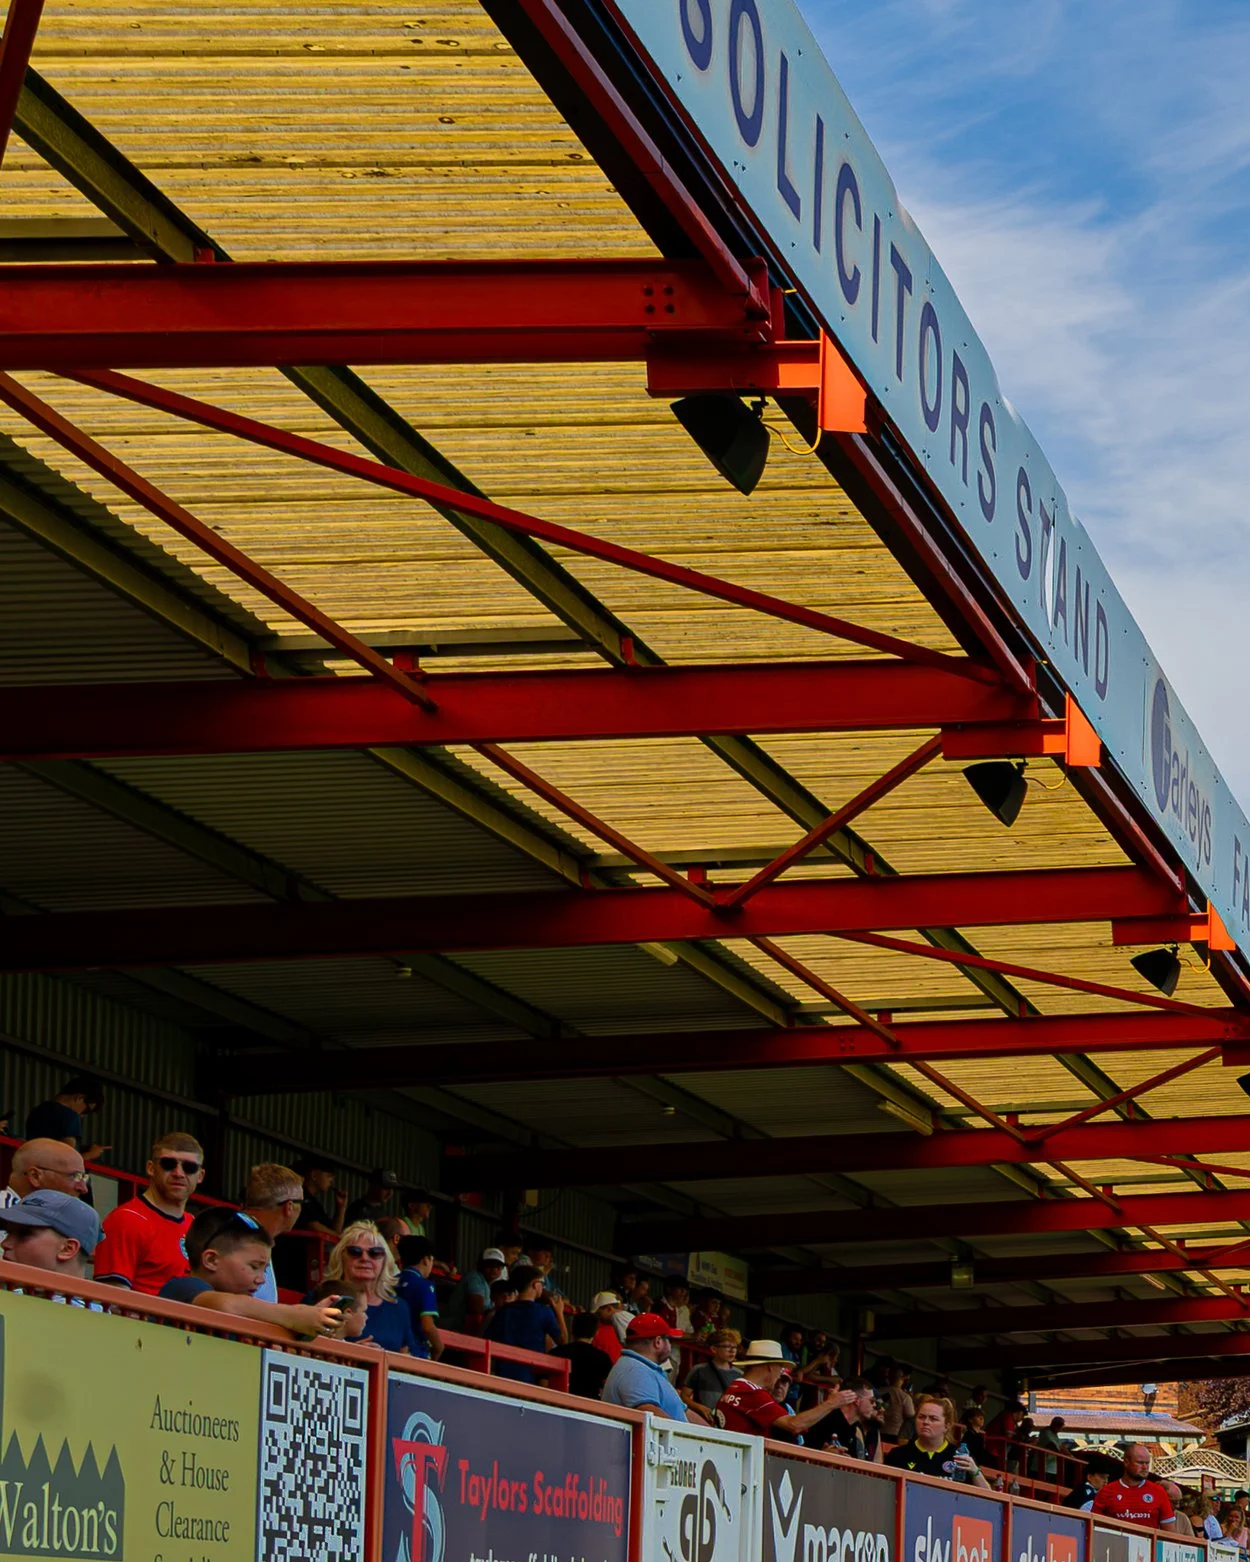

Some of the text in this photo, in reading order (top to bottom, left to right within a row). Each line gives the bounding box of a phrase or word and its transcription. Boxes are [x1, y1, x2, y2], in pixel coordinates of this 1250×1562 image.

[150, 1395, 240, 1442] Auctioneers
[160, 1450, 229, 1491] & House
[458, 1459, 624, 1537] Taylors Scaffolding
[155, 1501, 230, 1542] Clearance
